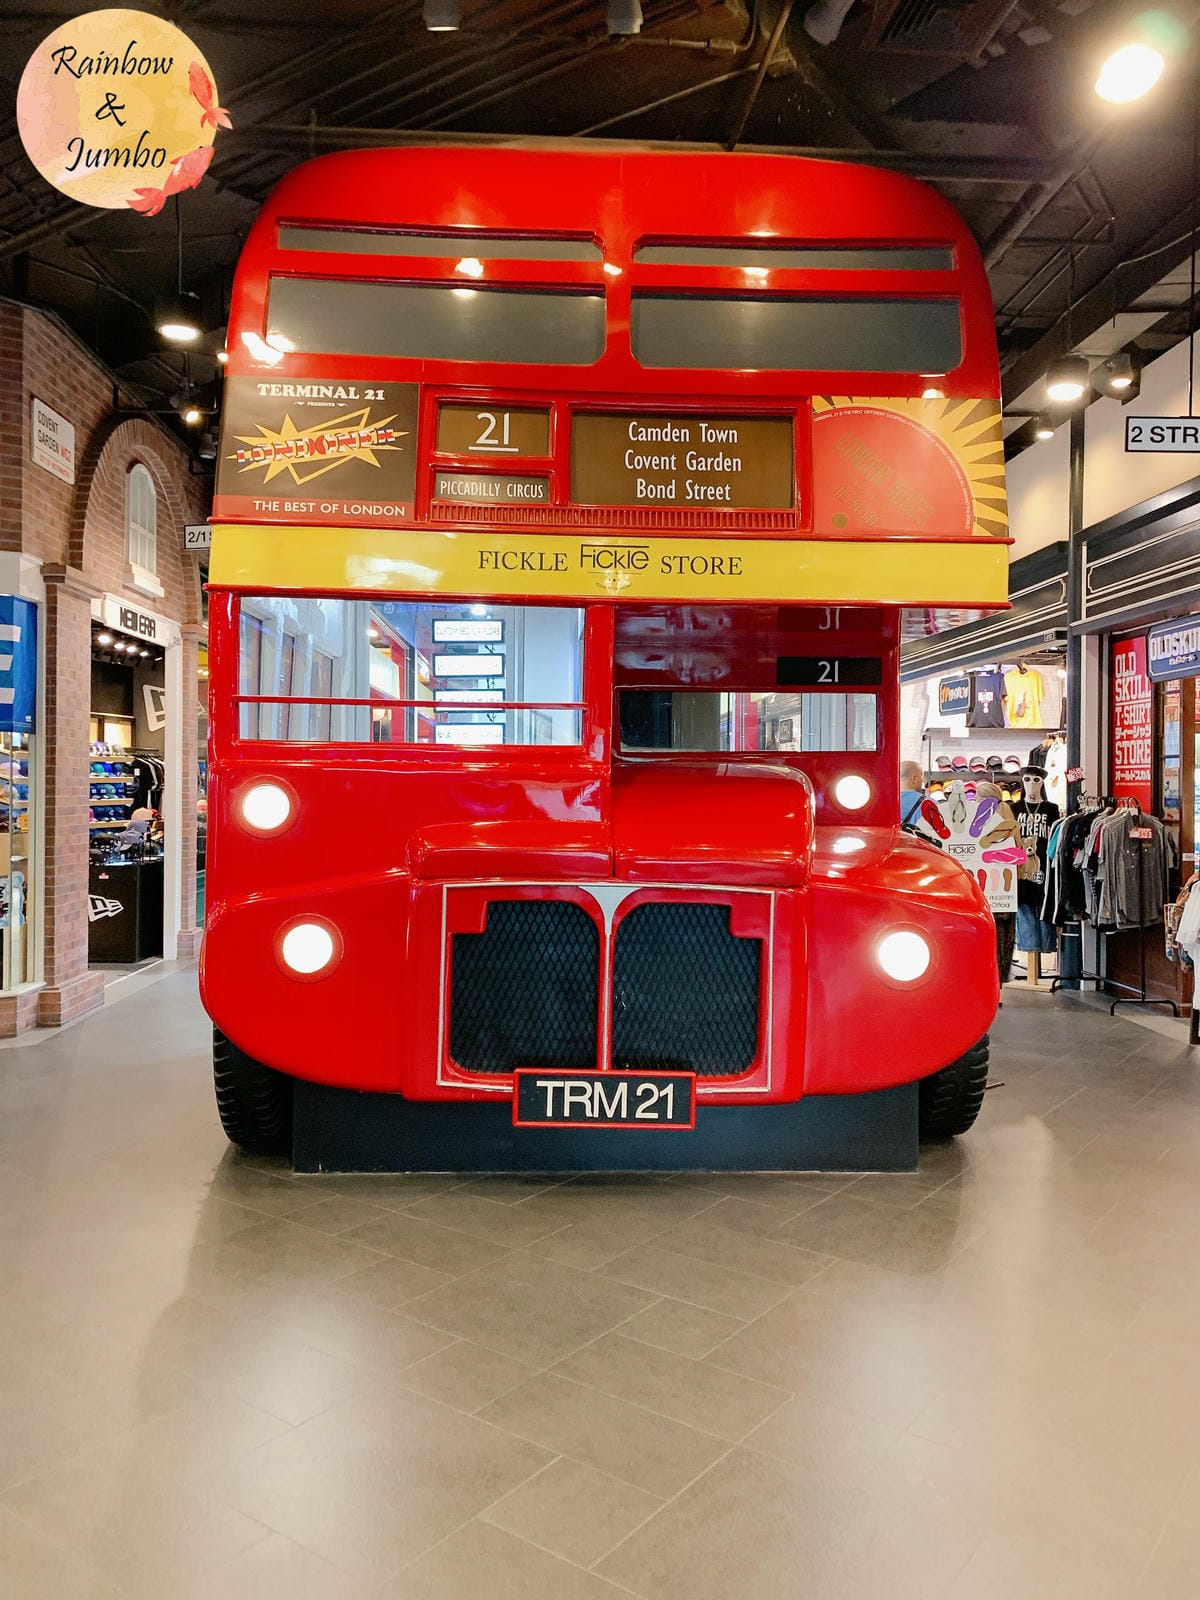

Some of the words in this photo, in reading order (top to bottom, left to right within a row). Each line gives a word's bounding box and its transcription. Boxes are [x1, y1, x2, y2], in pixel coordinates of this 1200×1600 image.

[257, 383, 360, 400] TERMINAL
[364, 389, 386, 401] 21
[38, 410, 58, 435] COVENT
[475, 412, 511, 445] 21
[628, 421, 690, 443] Camden
[699, 423, 738, 444] Town
[1131, 426, 1143, 443] 2
[624, 449, 676, 471] Covent
[685, 451, 742, 472] Garden
[440, 481, 500, 497] PICCADILLY
[507, 483, 544, 499] CIRCUS
[636, 478, 676, 500] Bond
[685, 480, 731, 501] Street
[253, 500, 280, 512] THE
[284, 501, 316, 513] BEST
[320, 503, 339, 514] OF
[343, 504, 405, 516] LONDON
[188, 531, 206, 543] 2/1
[478, 550, 569, 572] FICKLE
[580, 544, 649, 571] Fickle
[660, 555, 743, 576] STORE
[119, 606, 138, 632] NEW
[139, 614, 156, 639] ERA
[817, 660, 839, 683] 21
[1115, 651, 1137, 678] OLD
[1115, 673, 1152, 702] SKULL
[1115, 738, 1152, 765] STORE
[1017, 812, 1048, 824] MADE
[536, 1080, 628, 1119] TRM
[635, 1082, 674, 1120] 21
